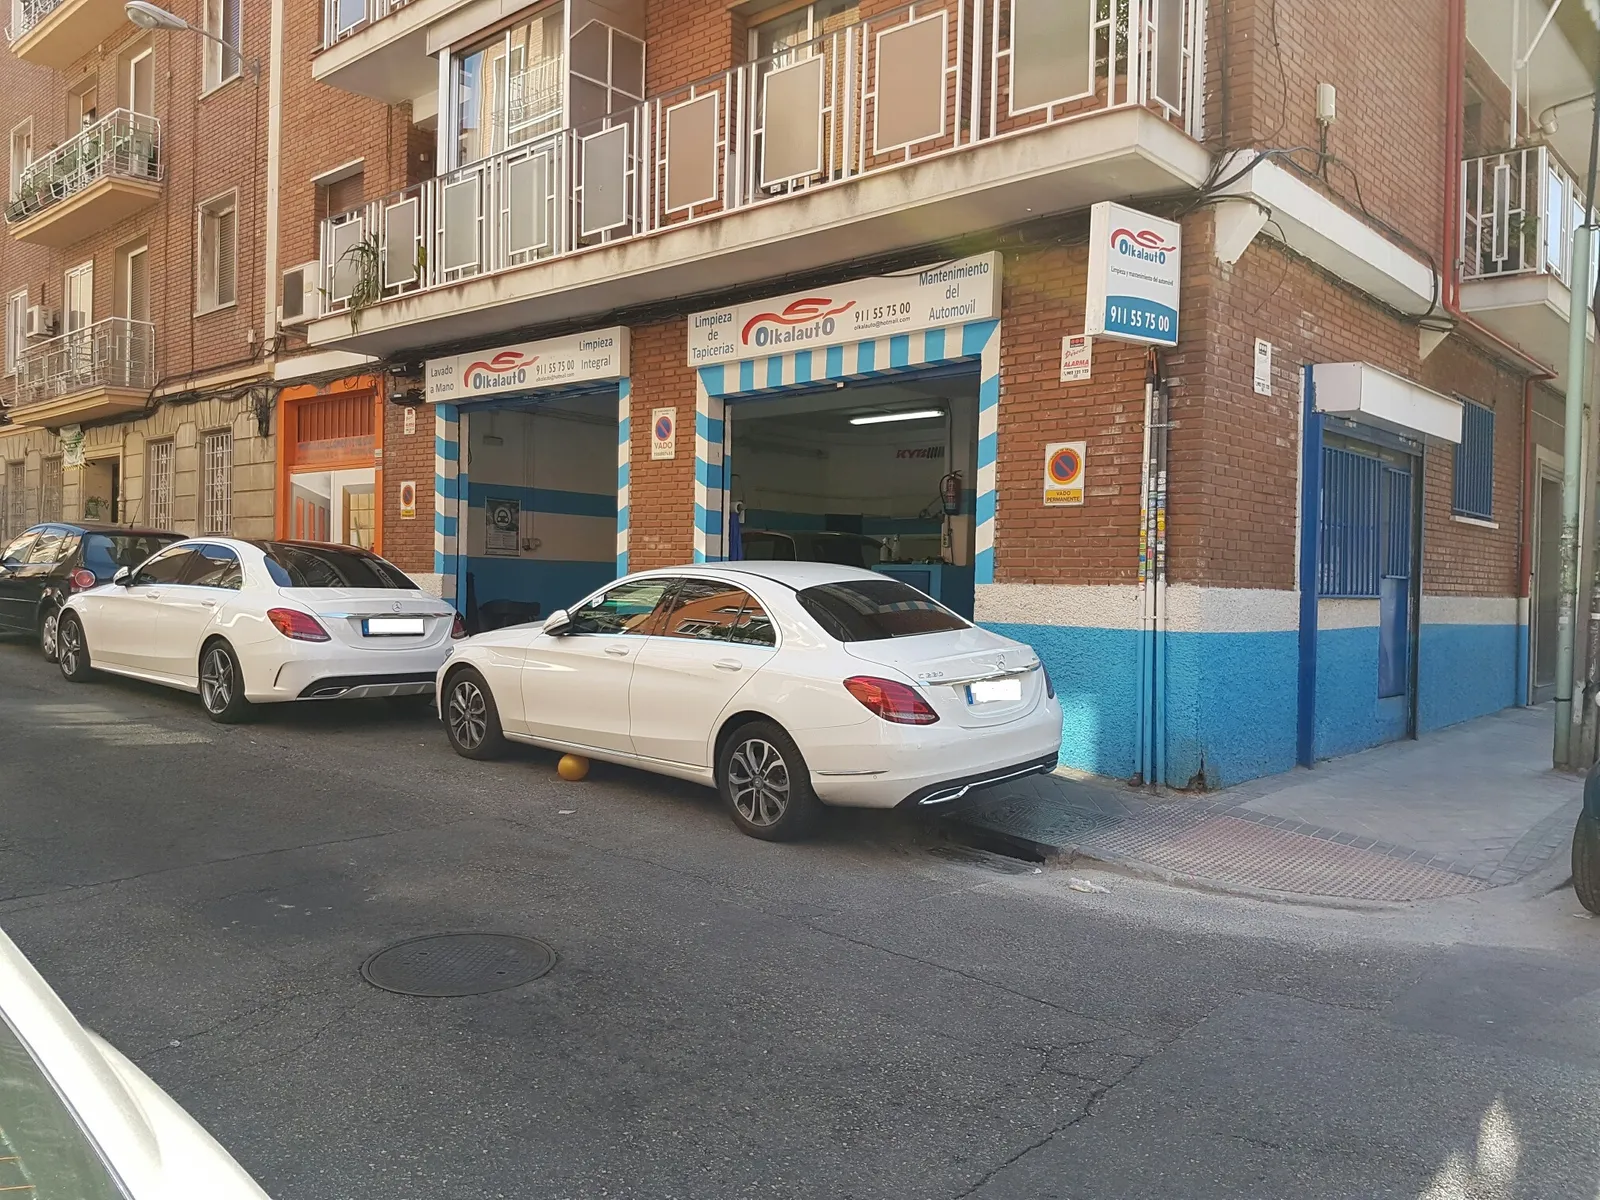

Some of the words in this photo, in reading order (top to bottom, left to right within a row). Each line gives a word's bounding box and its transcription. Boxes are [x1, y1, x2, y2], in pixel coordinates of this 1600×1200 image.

[919, 261, 989, 286] Mantenimiento
[945, 283, 960, 300] del
[854, 310, 869, 323] 911
[873, 306, 883, 320] 55
[886, 304, 897, 317] 75
[900, 301, 911, 314] 00
[928, 299, 976, 321] Automovil
[695, 312, 732, 328] Limpieza
[1110, 305, 1127, 325] 911
[1130, 309, 1142, 327] 55
[1145, 312, 1156, 330] 75
[1158, 315, 1170, 333] 00
[707, 328, 719, 342] de
[579, 337, 613, 352] Limpieza
[692, 342, 734, 360] Tapicerias
[536, 364, 547, 375] 911
[548, 362, 556, 373] 55
[558, 361, 565, 372] 75
[566, 359, 575, 370] 00
[581, 354, 611, 370] Integral
[1063, 359, 1089, 368] ALARMA
[430, 364, 453, 378] Lavado
[430, 386, 435, 394] a
[435, 382, 455, 393] Mano
[654, 441, 673, 450] VADO
[896, 448, 927, 459] KYB
